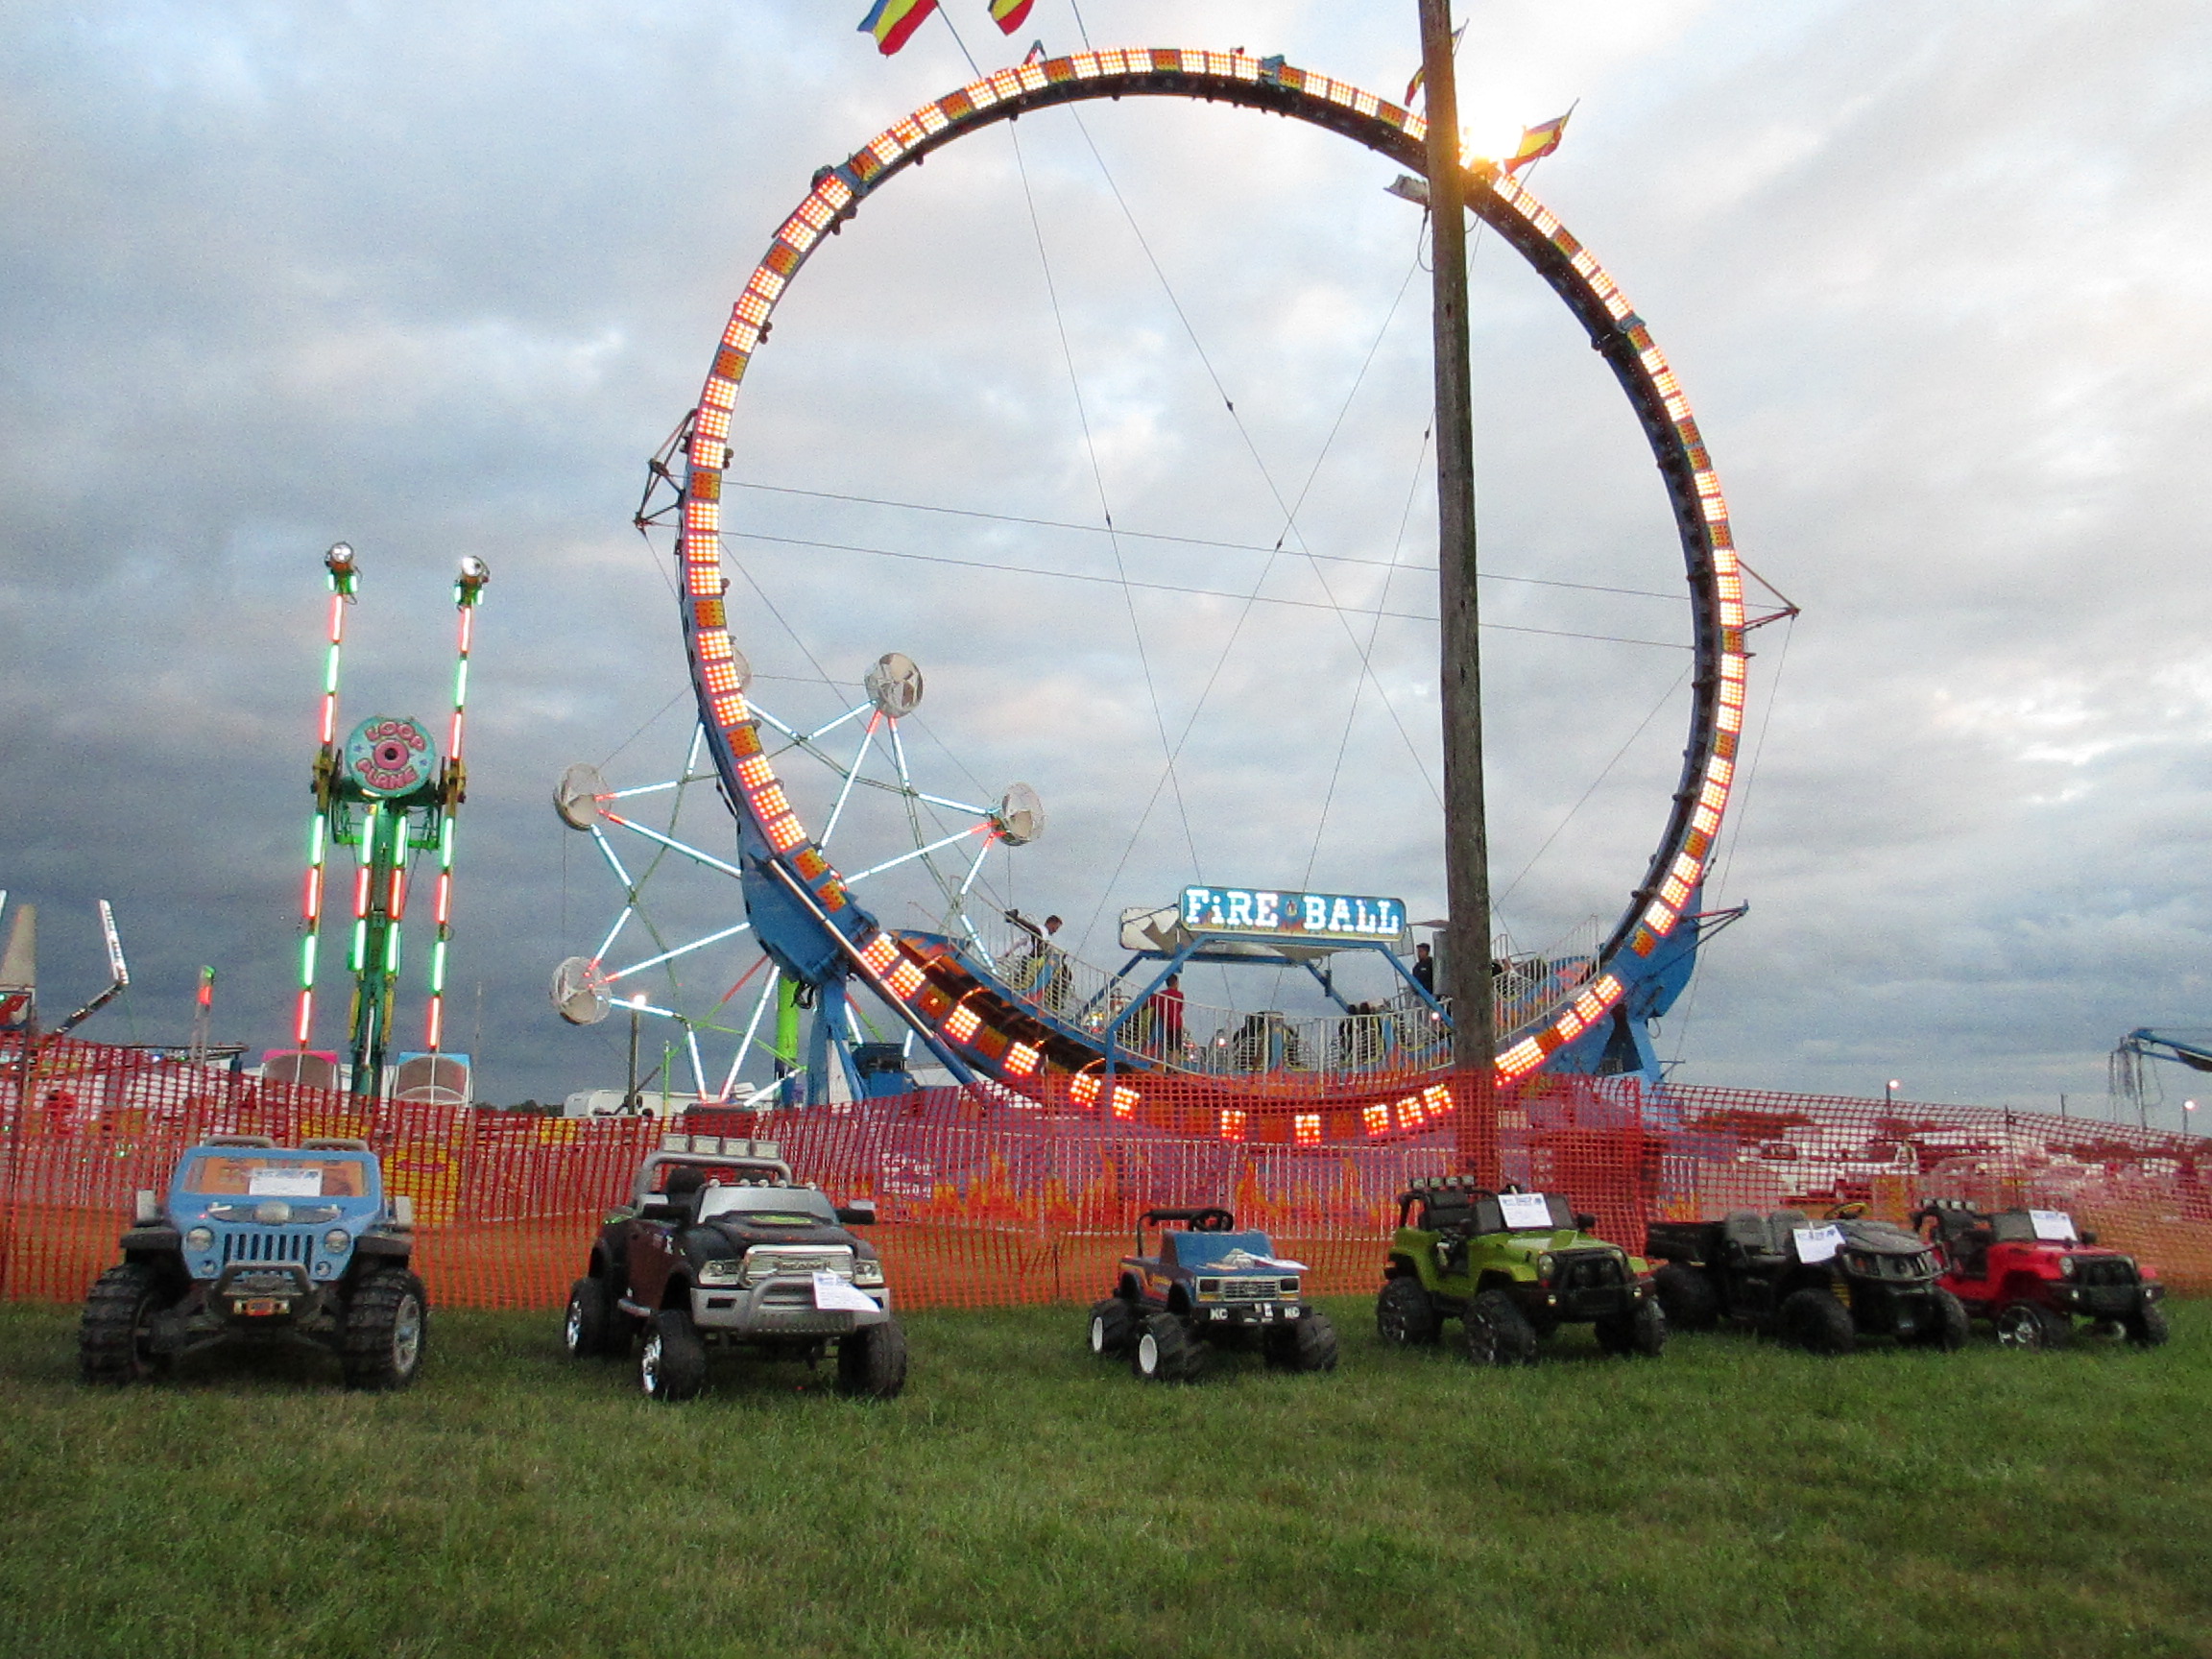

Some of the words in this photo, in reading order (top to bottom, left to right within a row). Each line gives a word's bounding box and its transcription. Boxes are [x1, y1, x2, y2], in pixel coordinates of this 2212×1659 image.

[366, 722, 424, 751] LOOP
[1303, 896, 1399, 934] BALL
[1211, 1308, 1228, 1319] KC
